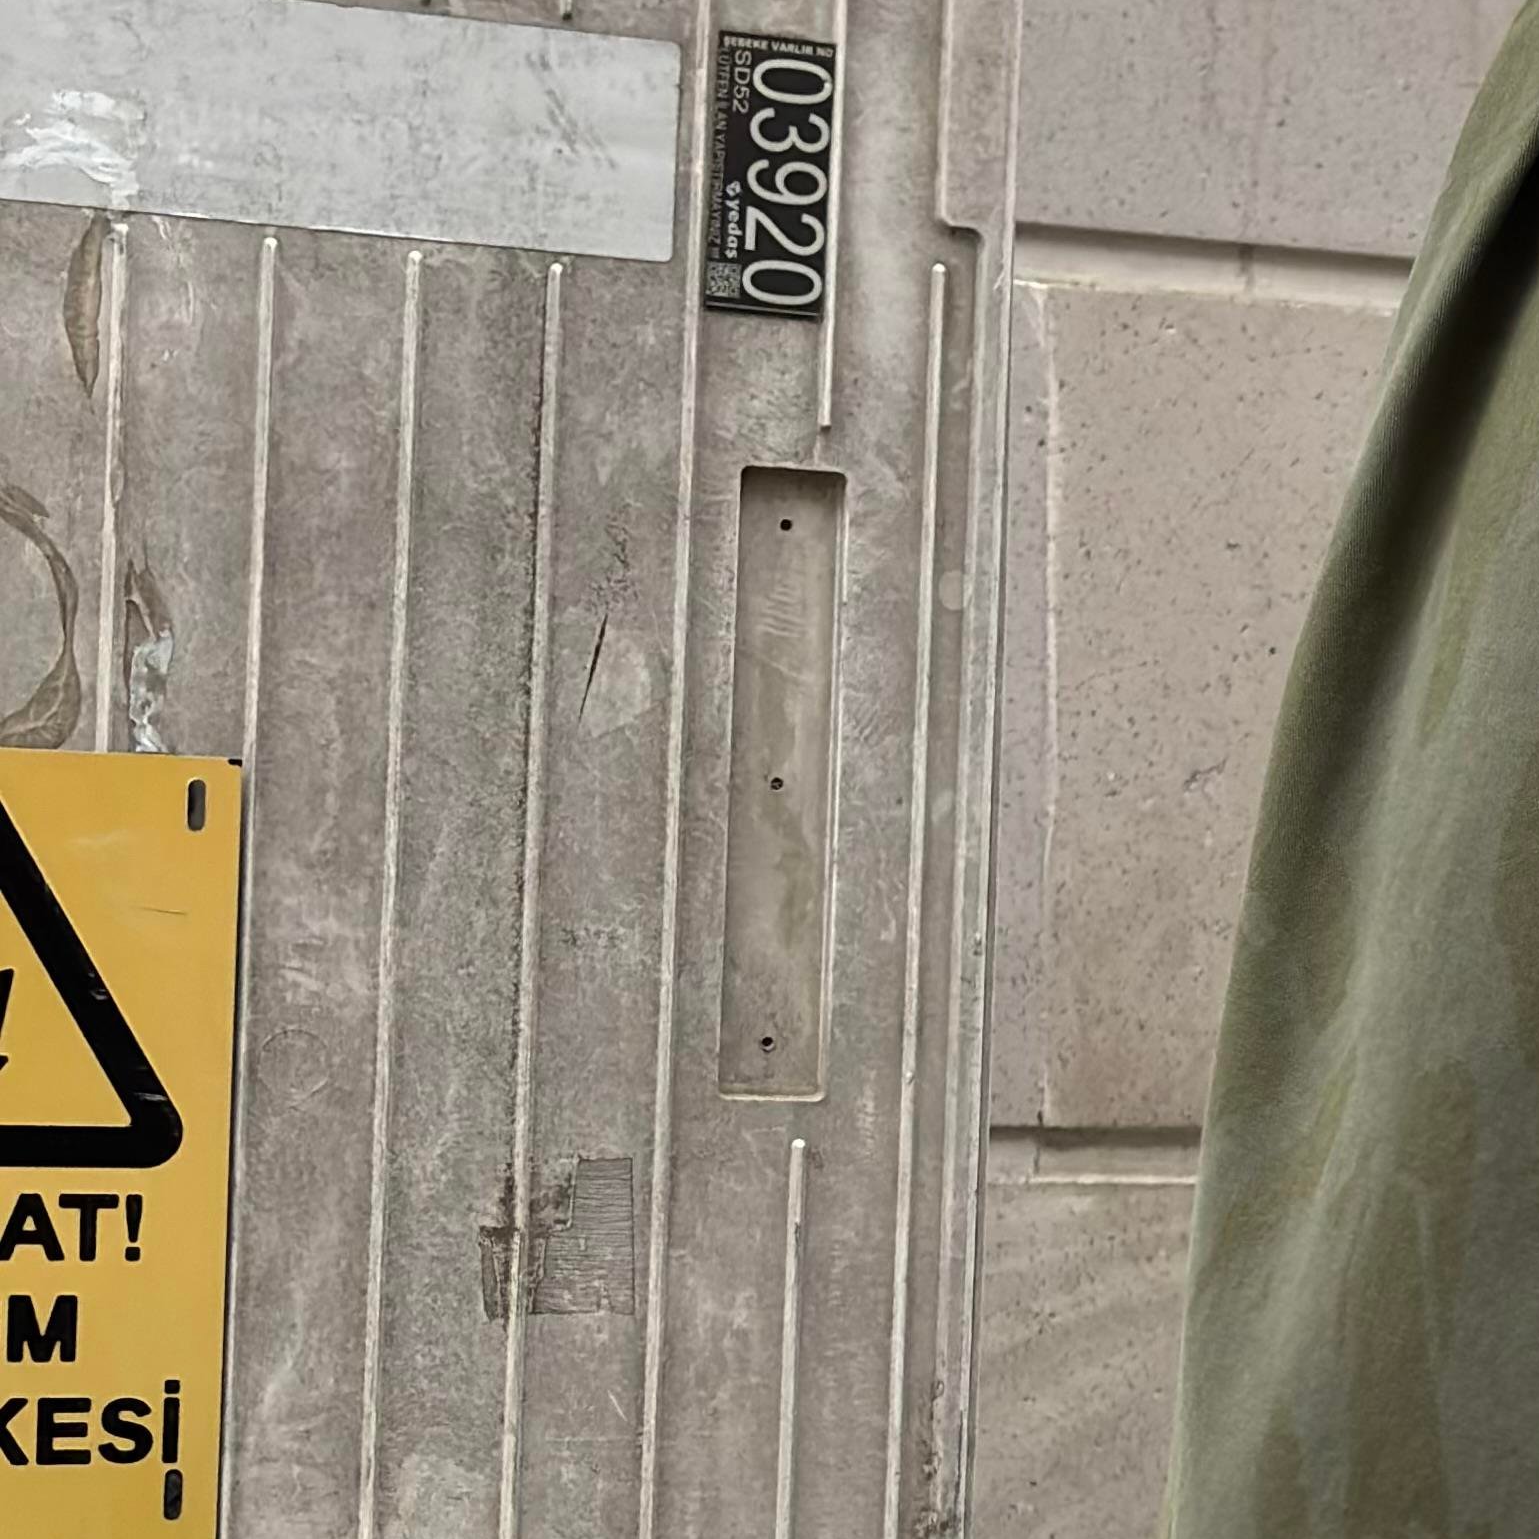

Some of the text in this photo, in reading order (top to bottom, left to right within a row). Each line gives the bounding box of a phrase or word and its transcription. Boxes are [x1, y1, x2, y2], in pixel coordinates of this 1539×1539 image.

[732, 49, 752, 114] SD52
[741, 58, 833, 306] 03920
[724, 199, 743, 259] yedaş
